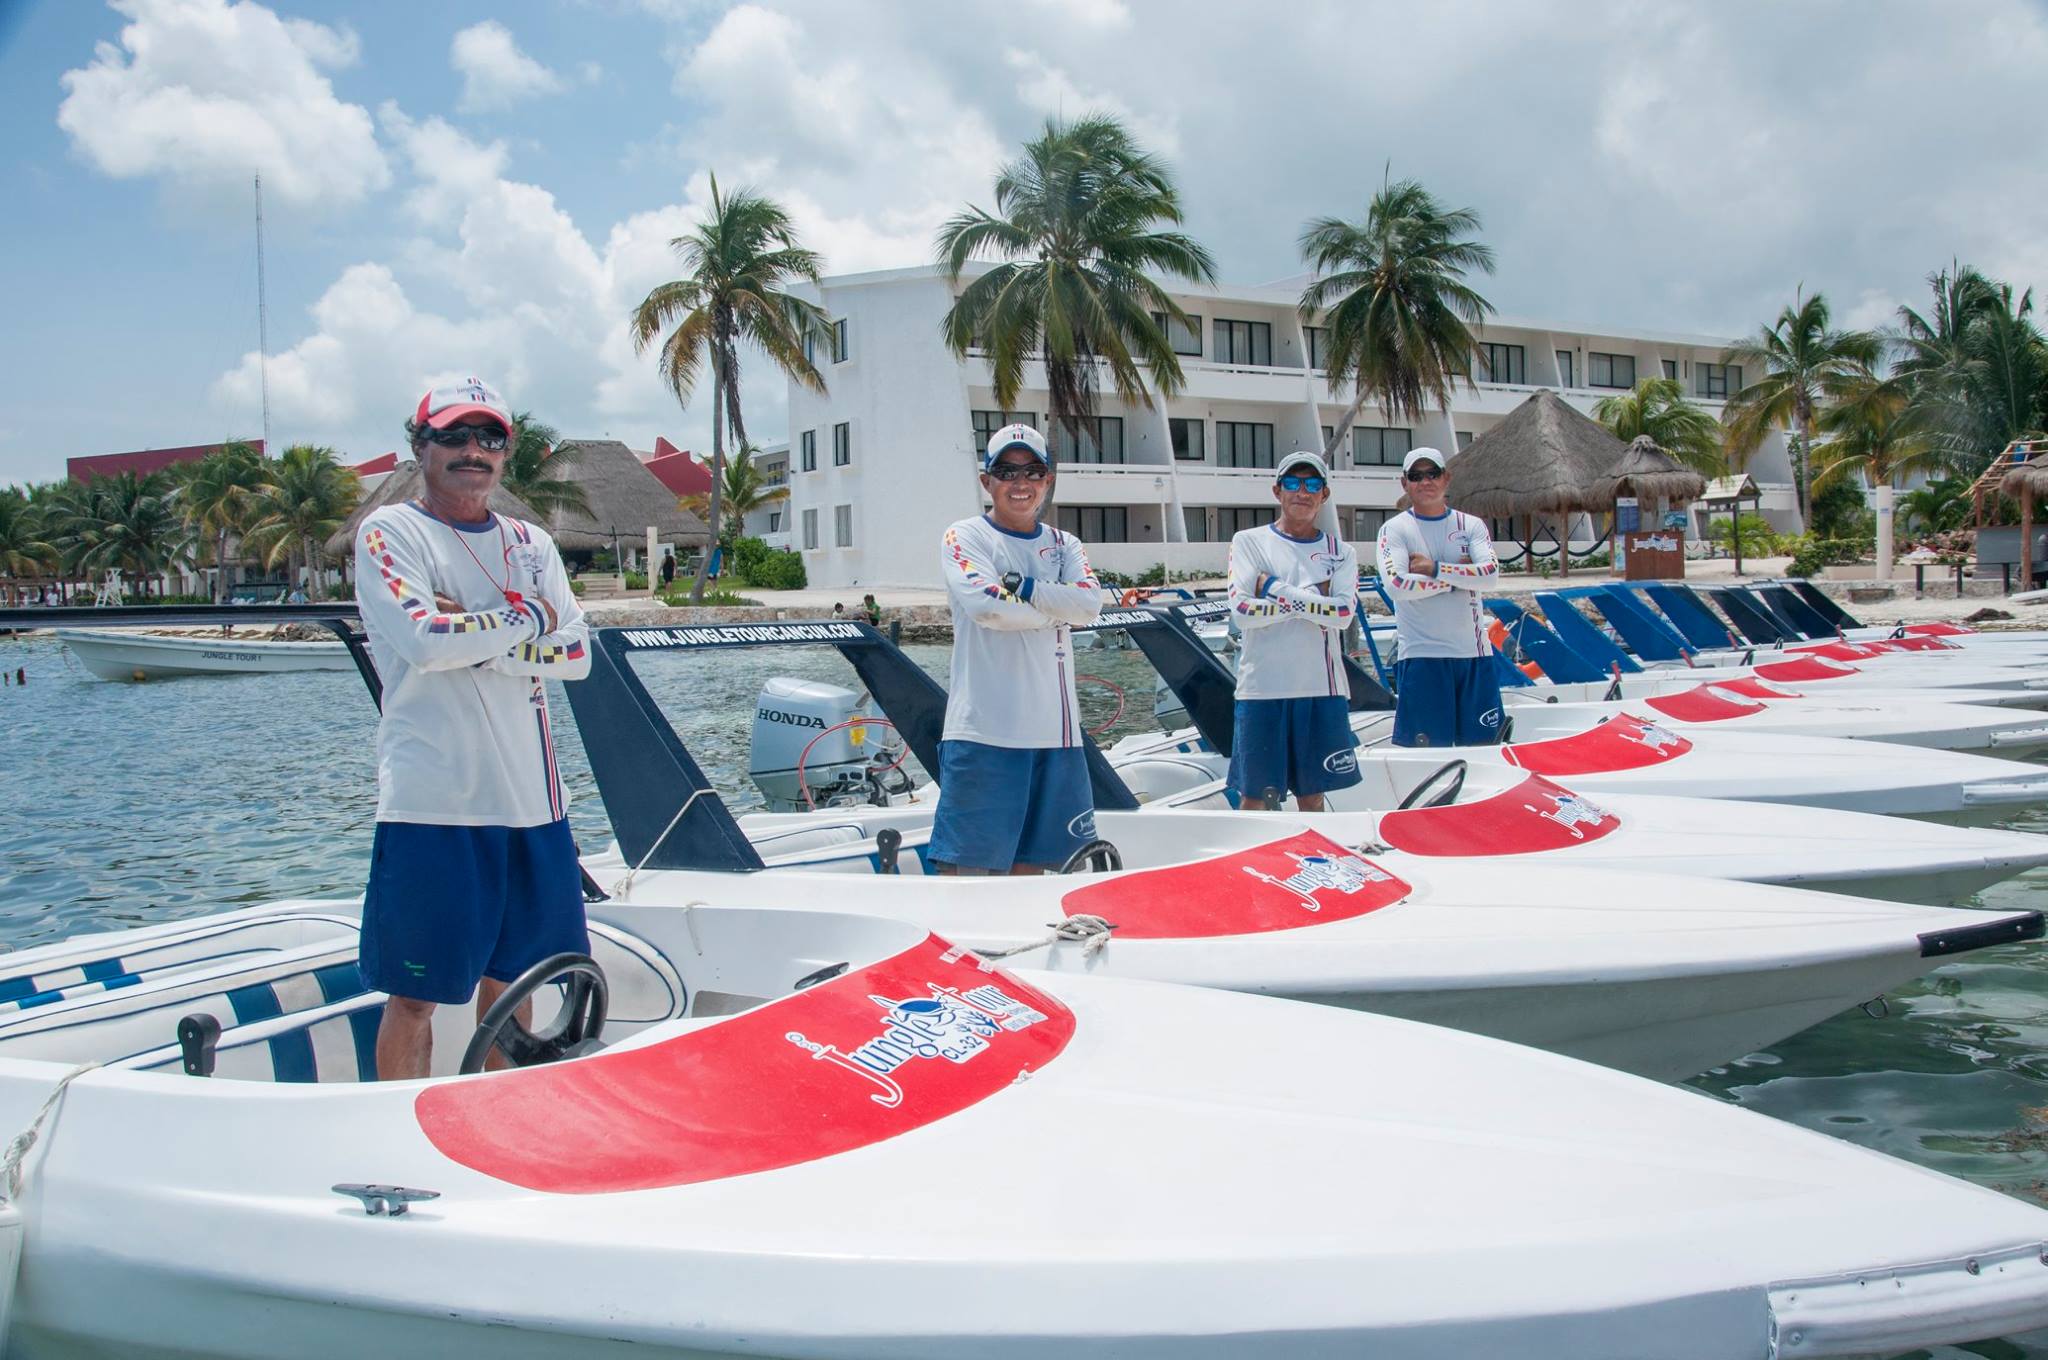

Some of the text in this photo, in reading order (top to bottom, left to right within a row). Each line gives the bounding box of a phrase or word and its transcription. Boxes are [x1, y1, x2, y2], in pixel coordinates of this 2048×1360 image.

[622, 623, 864, 648] WWW.JUNGLETOURCANCUN.COM
[202, 651, 233, 661] JUNGLE
[235, 653, 257, 662] TOUR
[758, 708, 828, 730] HONDA
[941, 1036, 983, 1060] CL-32
[786, 1015, 947, 1108] Jungle
